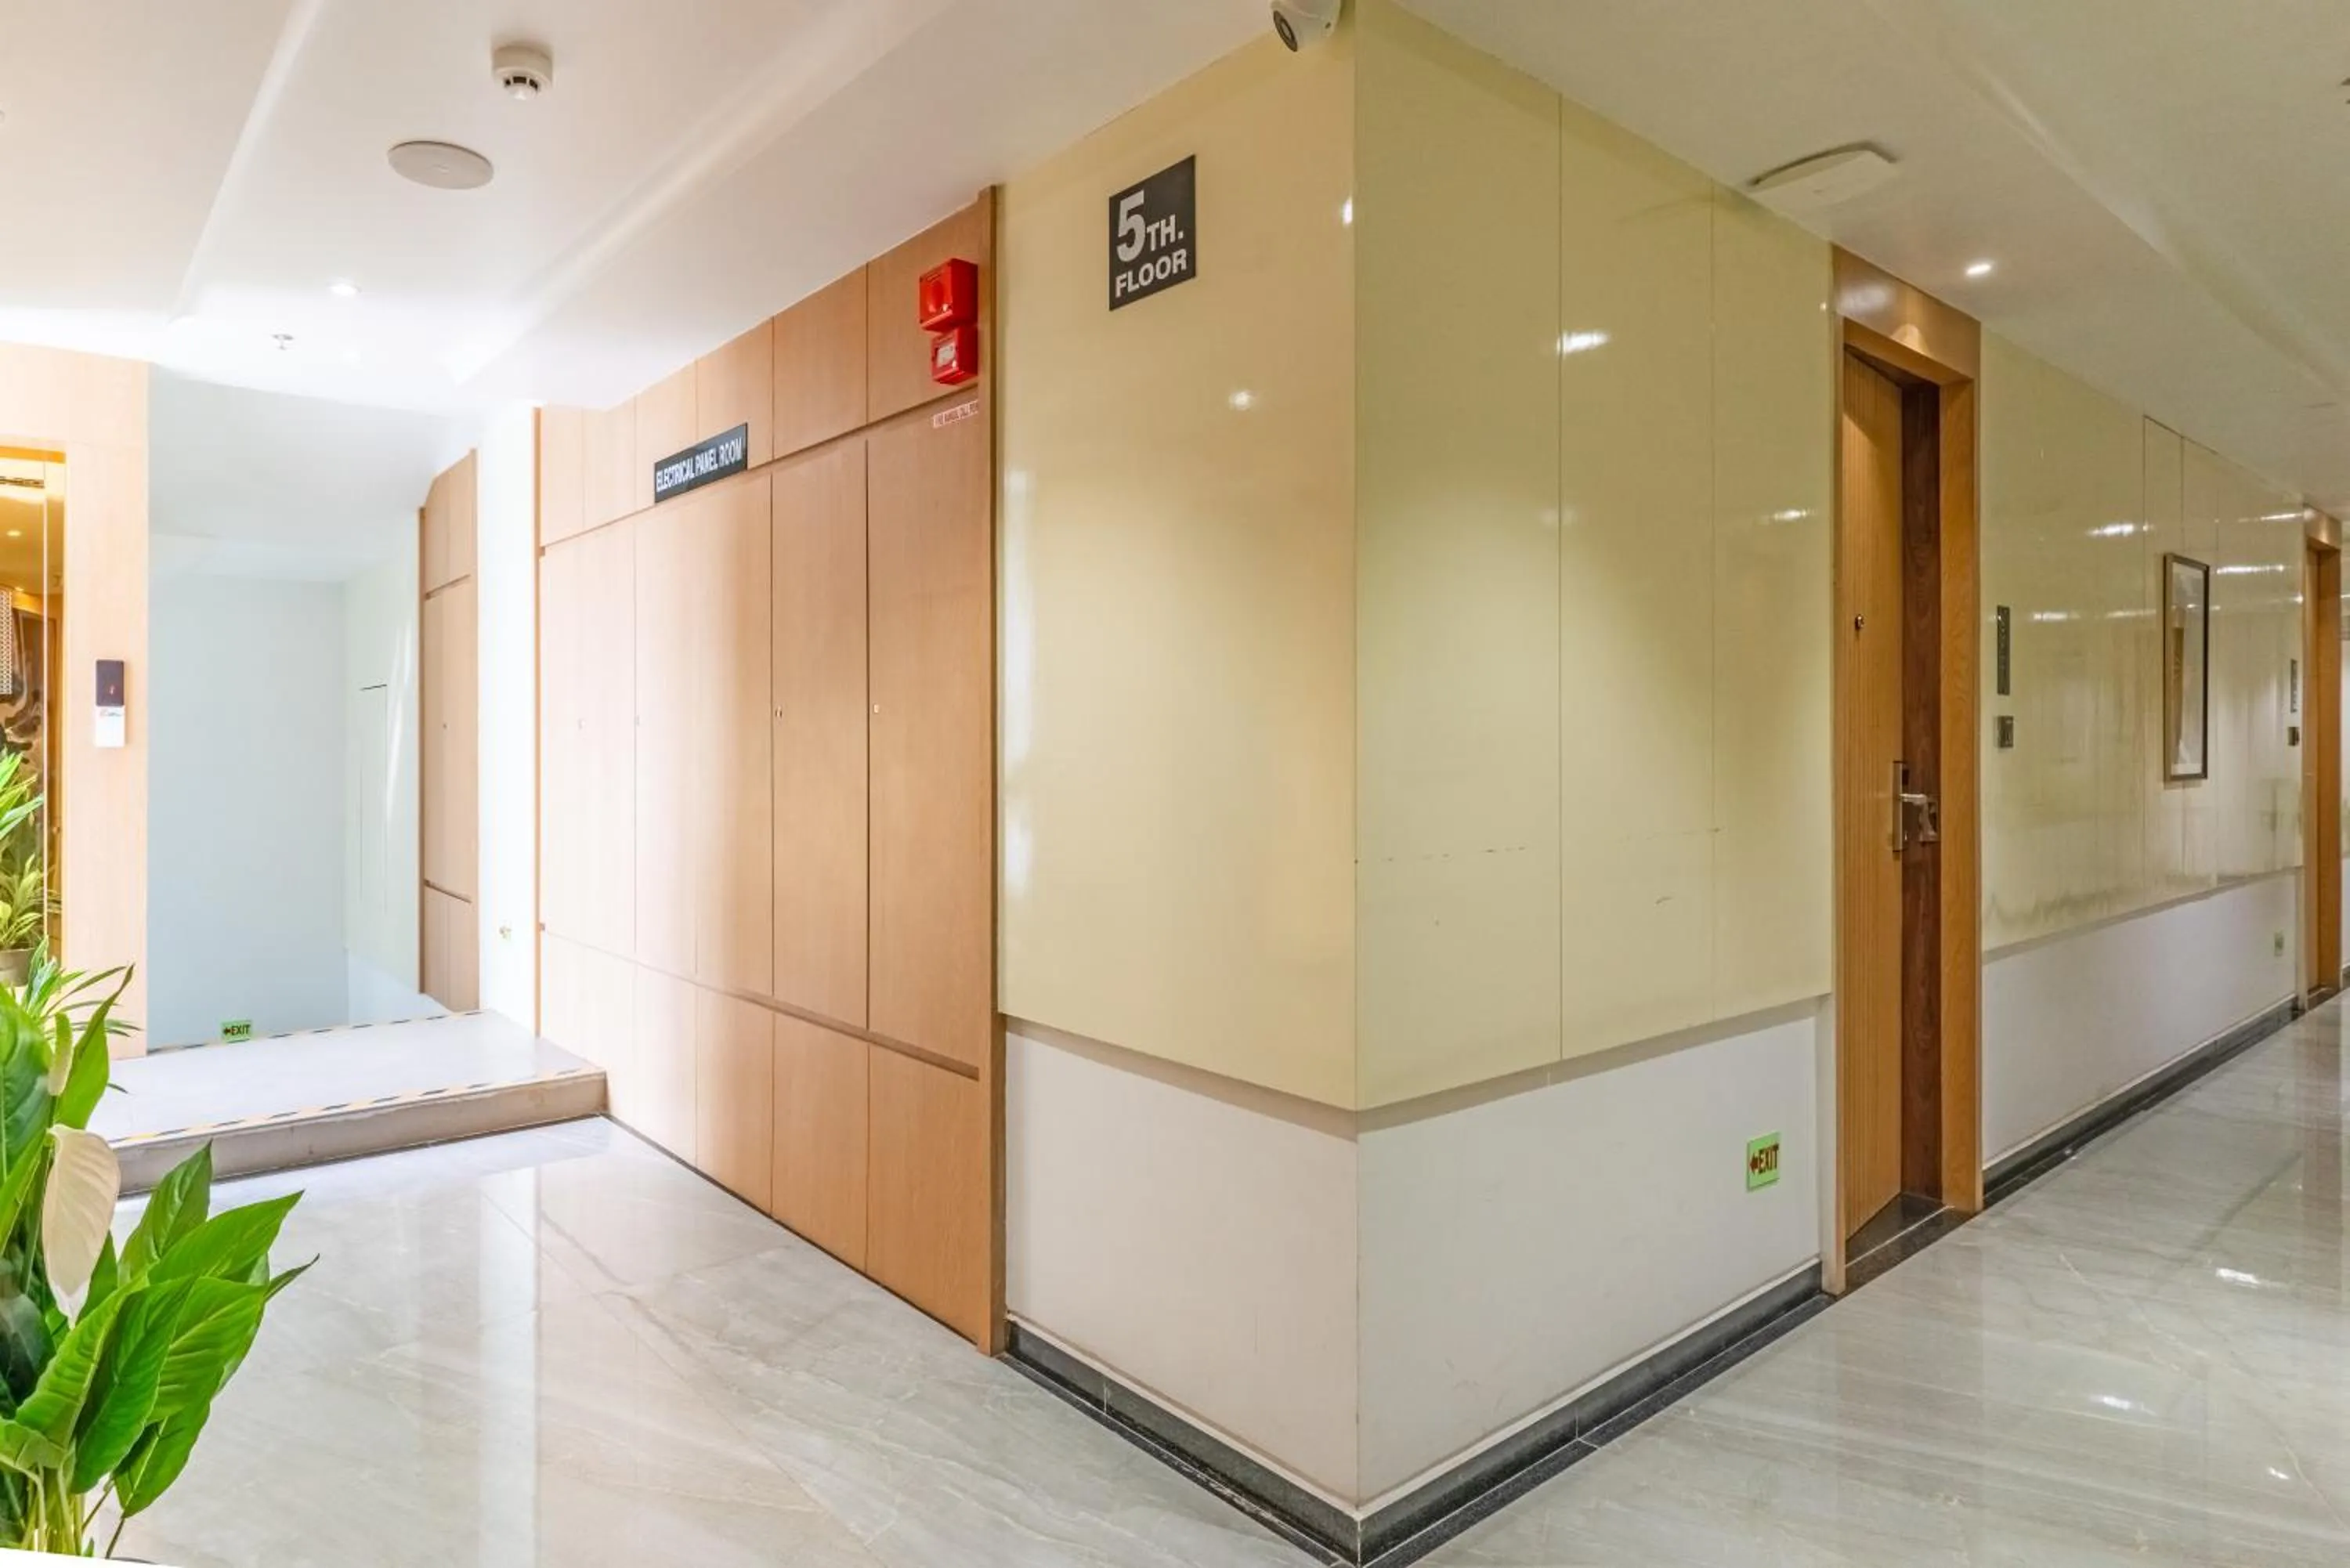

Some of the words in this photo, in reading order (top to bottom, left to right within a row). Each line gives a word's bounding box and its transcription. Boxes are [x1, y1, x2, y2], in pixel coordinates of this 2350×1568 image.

[1116, 190, 1184, 262] 5TH.
[1115, 248, 1187, 298] FLOOR
[656, 457, 696, 492] ELECTRICAL
[695, 447, 718, 476] PANEL
[718, 437, 743, 468] ROOM
[231, 1024, 251, 1035] EXIT
[1759, 1143, 1779, 1174] EXIT
